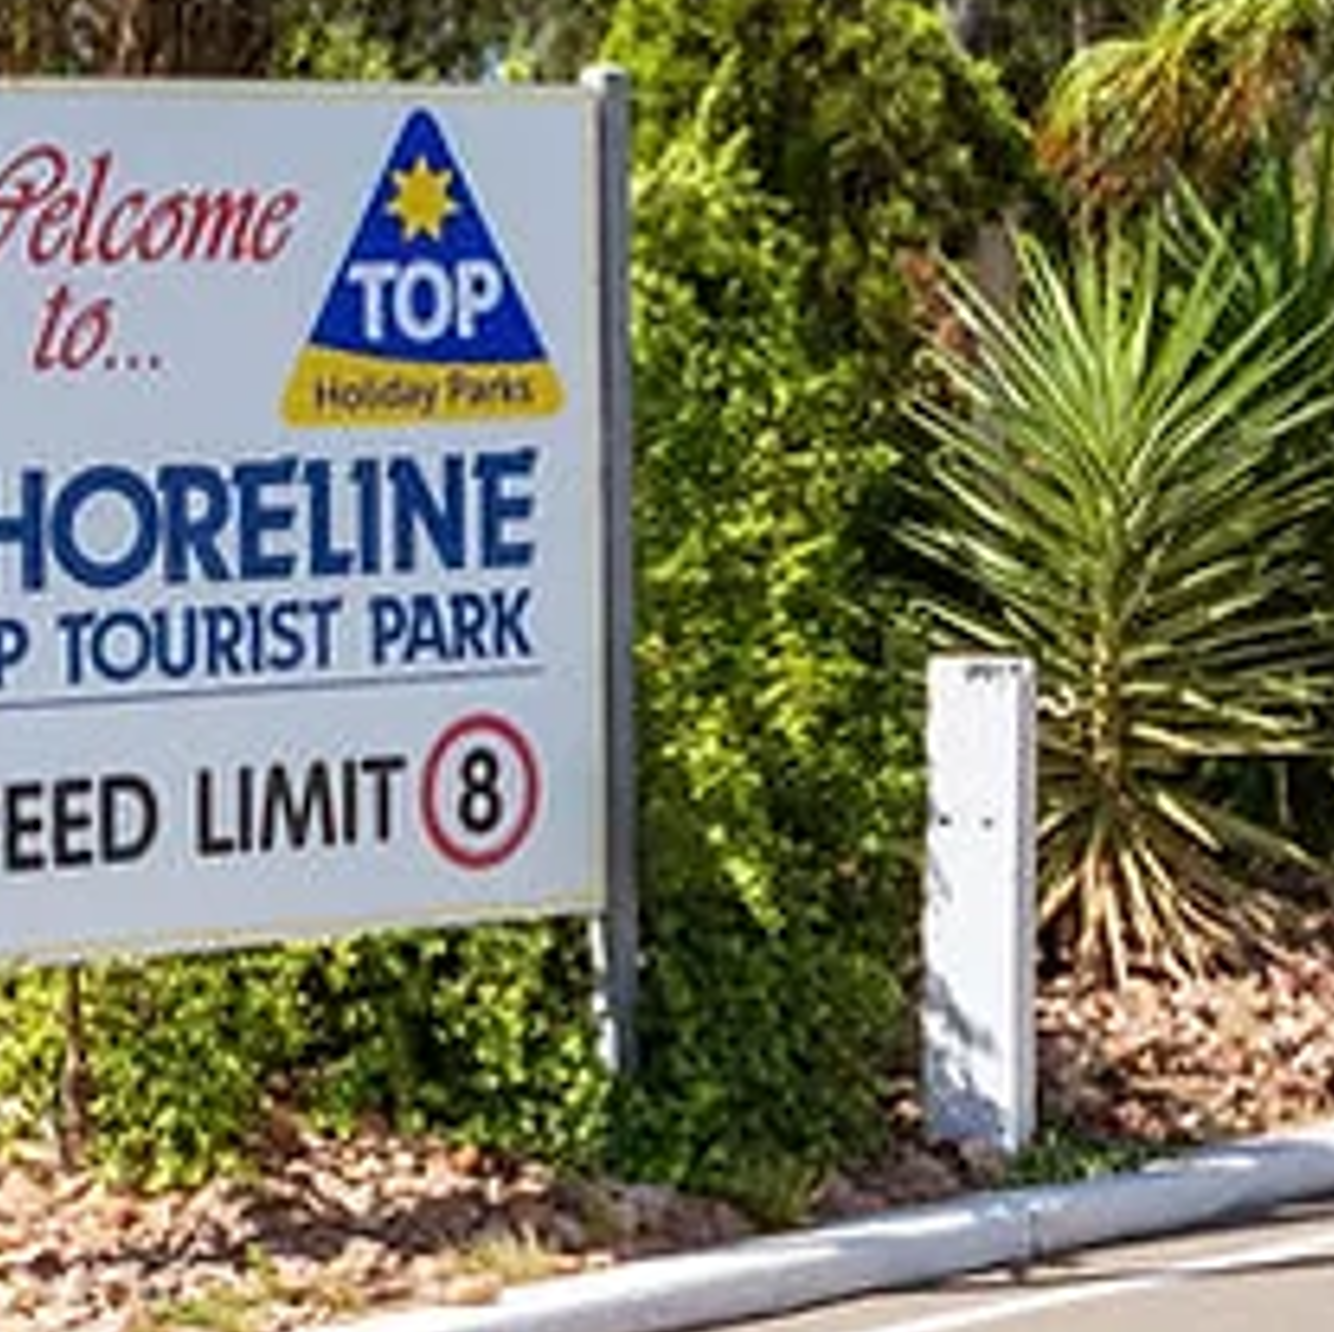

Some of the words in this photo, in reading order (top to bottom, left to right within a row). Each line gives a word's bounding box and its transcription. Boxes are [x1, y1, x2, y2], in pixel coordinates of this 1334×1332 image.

[348, 262, 504, 342] TOP
[314, 372, 437, 417] Holiday
[446, 371, 533, 408] Parks
[59, 599, 342, 685] TOURIST
[370, 588, 532, 664] PARK
[197, 755, 407, 856] LIMIT
[456, 748, 503, 834] 8
